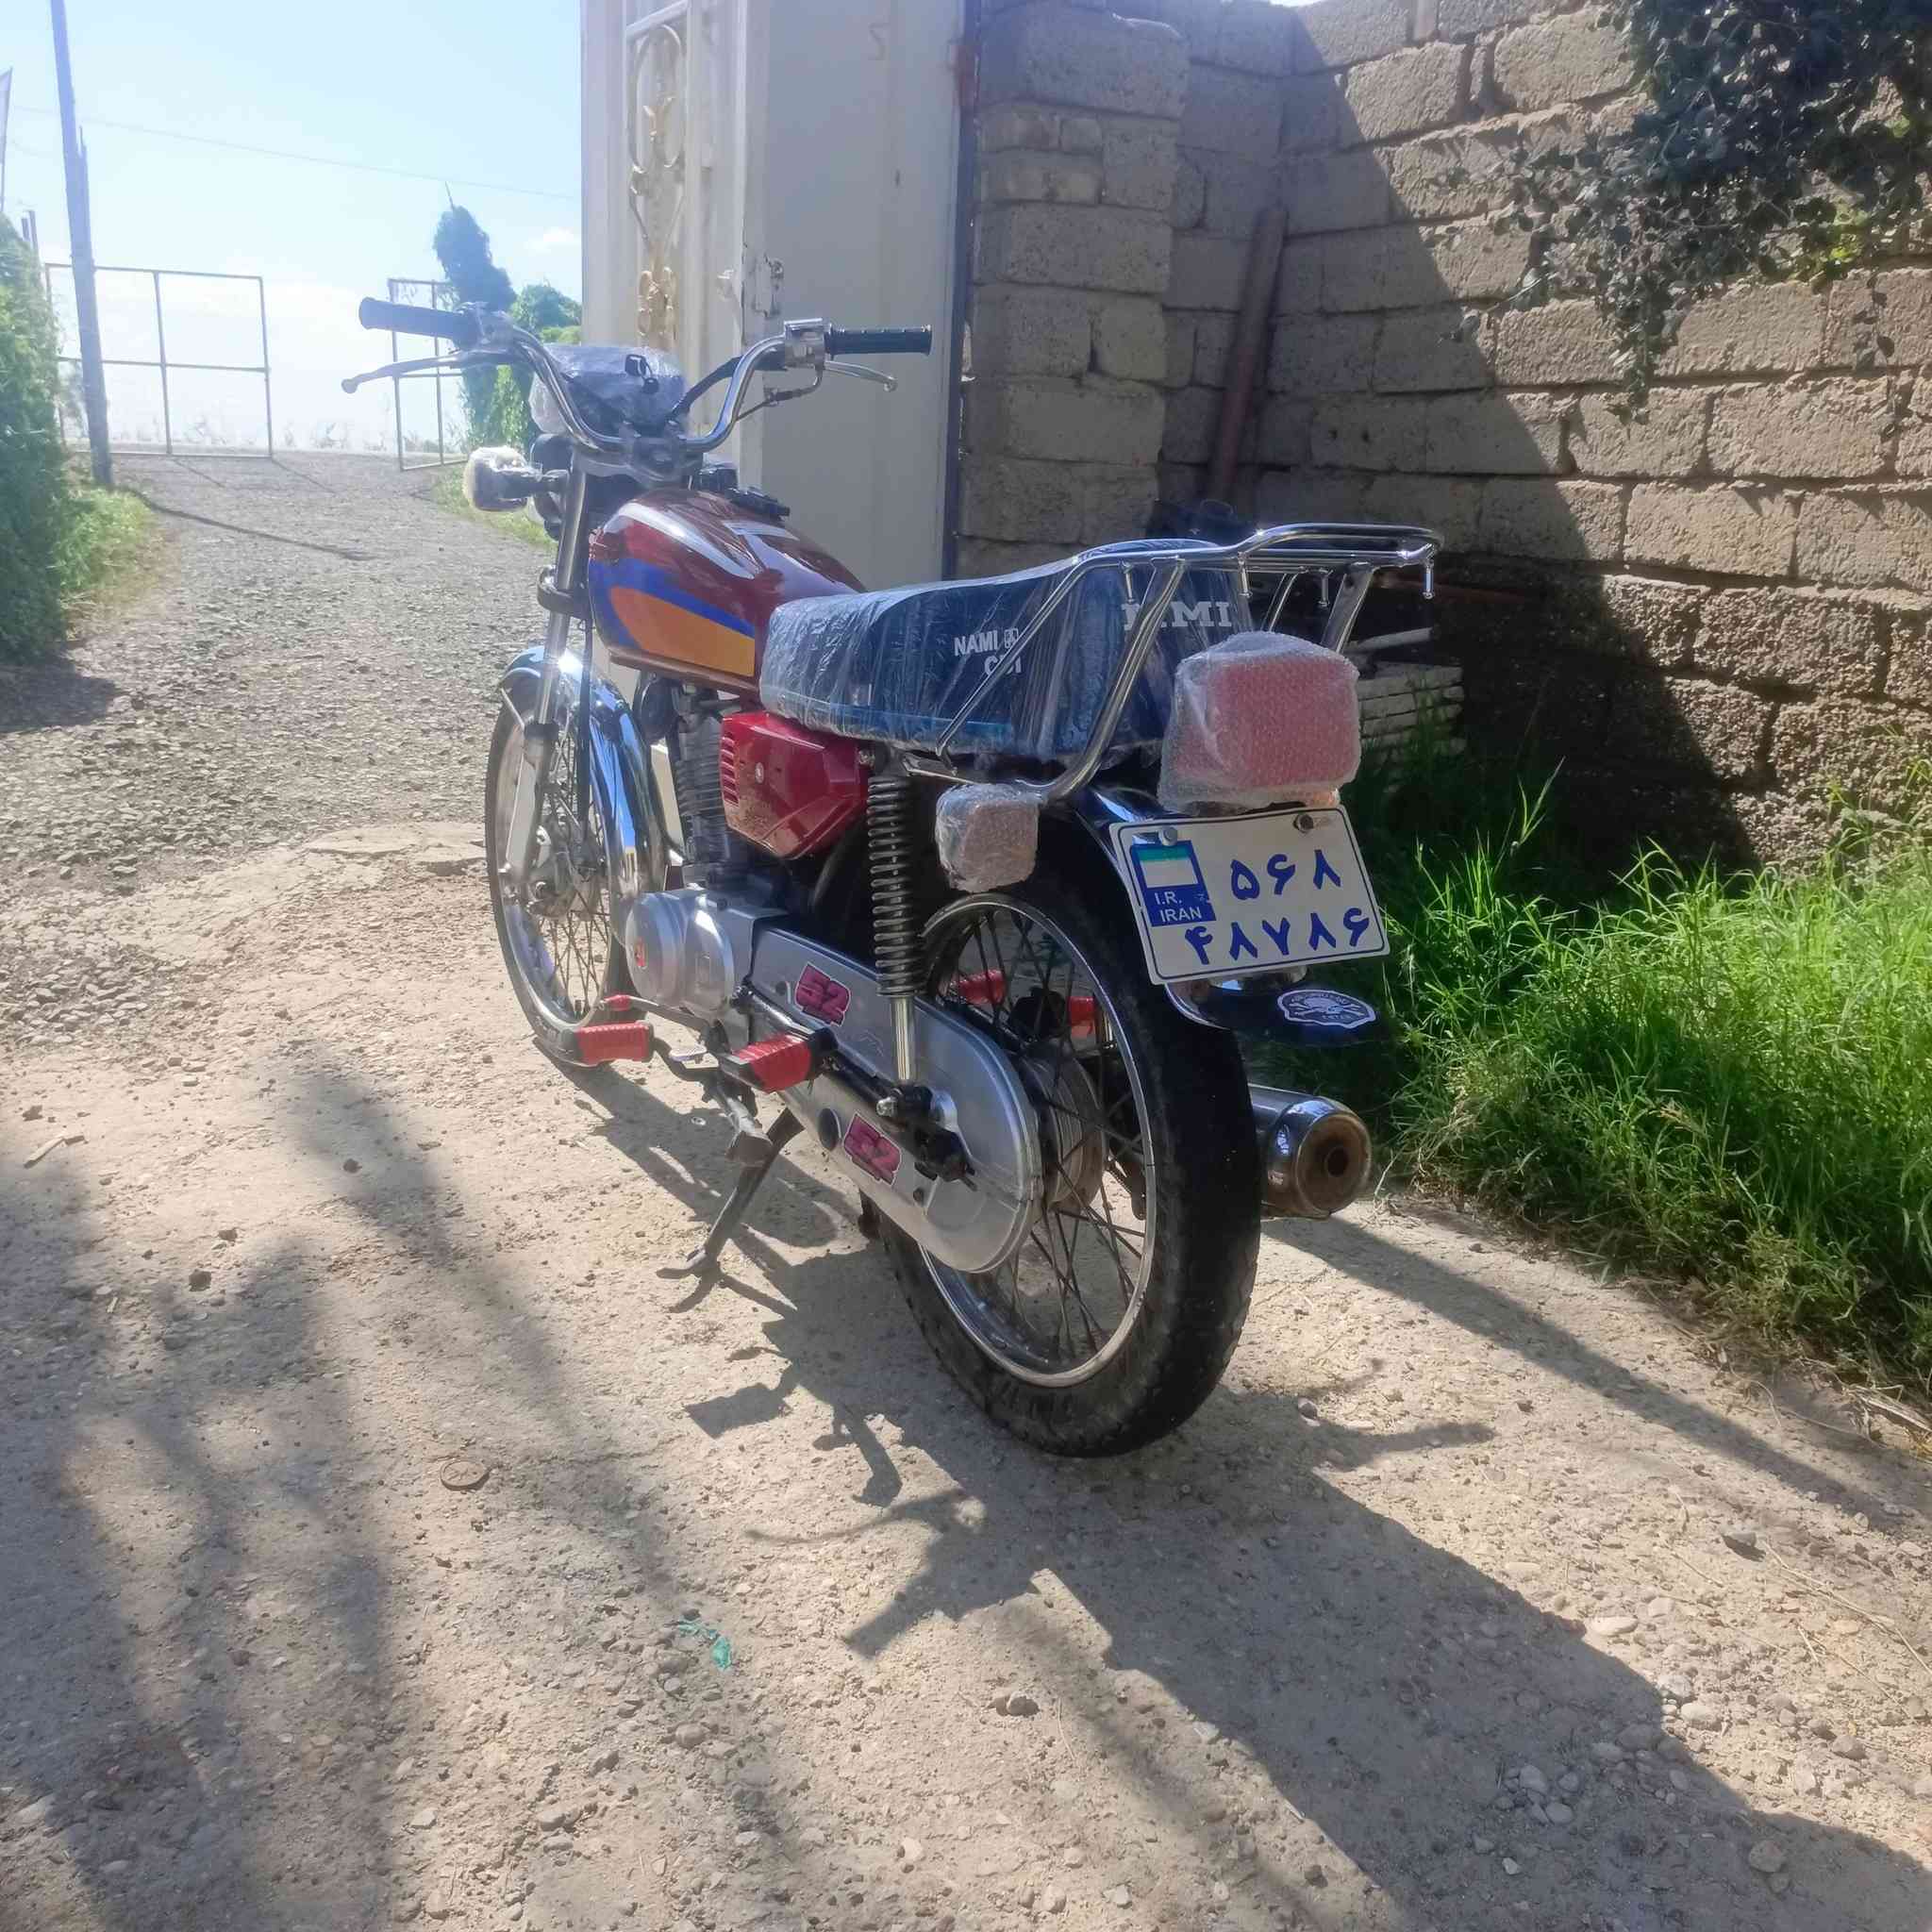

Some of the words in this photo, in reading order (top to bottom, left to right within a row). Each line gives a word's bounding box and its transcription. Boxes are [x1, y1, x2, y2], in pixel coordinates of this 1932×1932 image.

[1121, 601, 1232, 631] MI
[954, 630, 998, 657] NAMI
[1230, 849, 1341, 900] ۵۶۸
[1154, 891, 1183, 906] I.R.
[1159, 906, 1203, 923] IRAN
[1185, 908, 1370, 966] ۴۸۷۸۶
